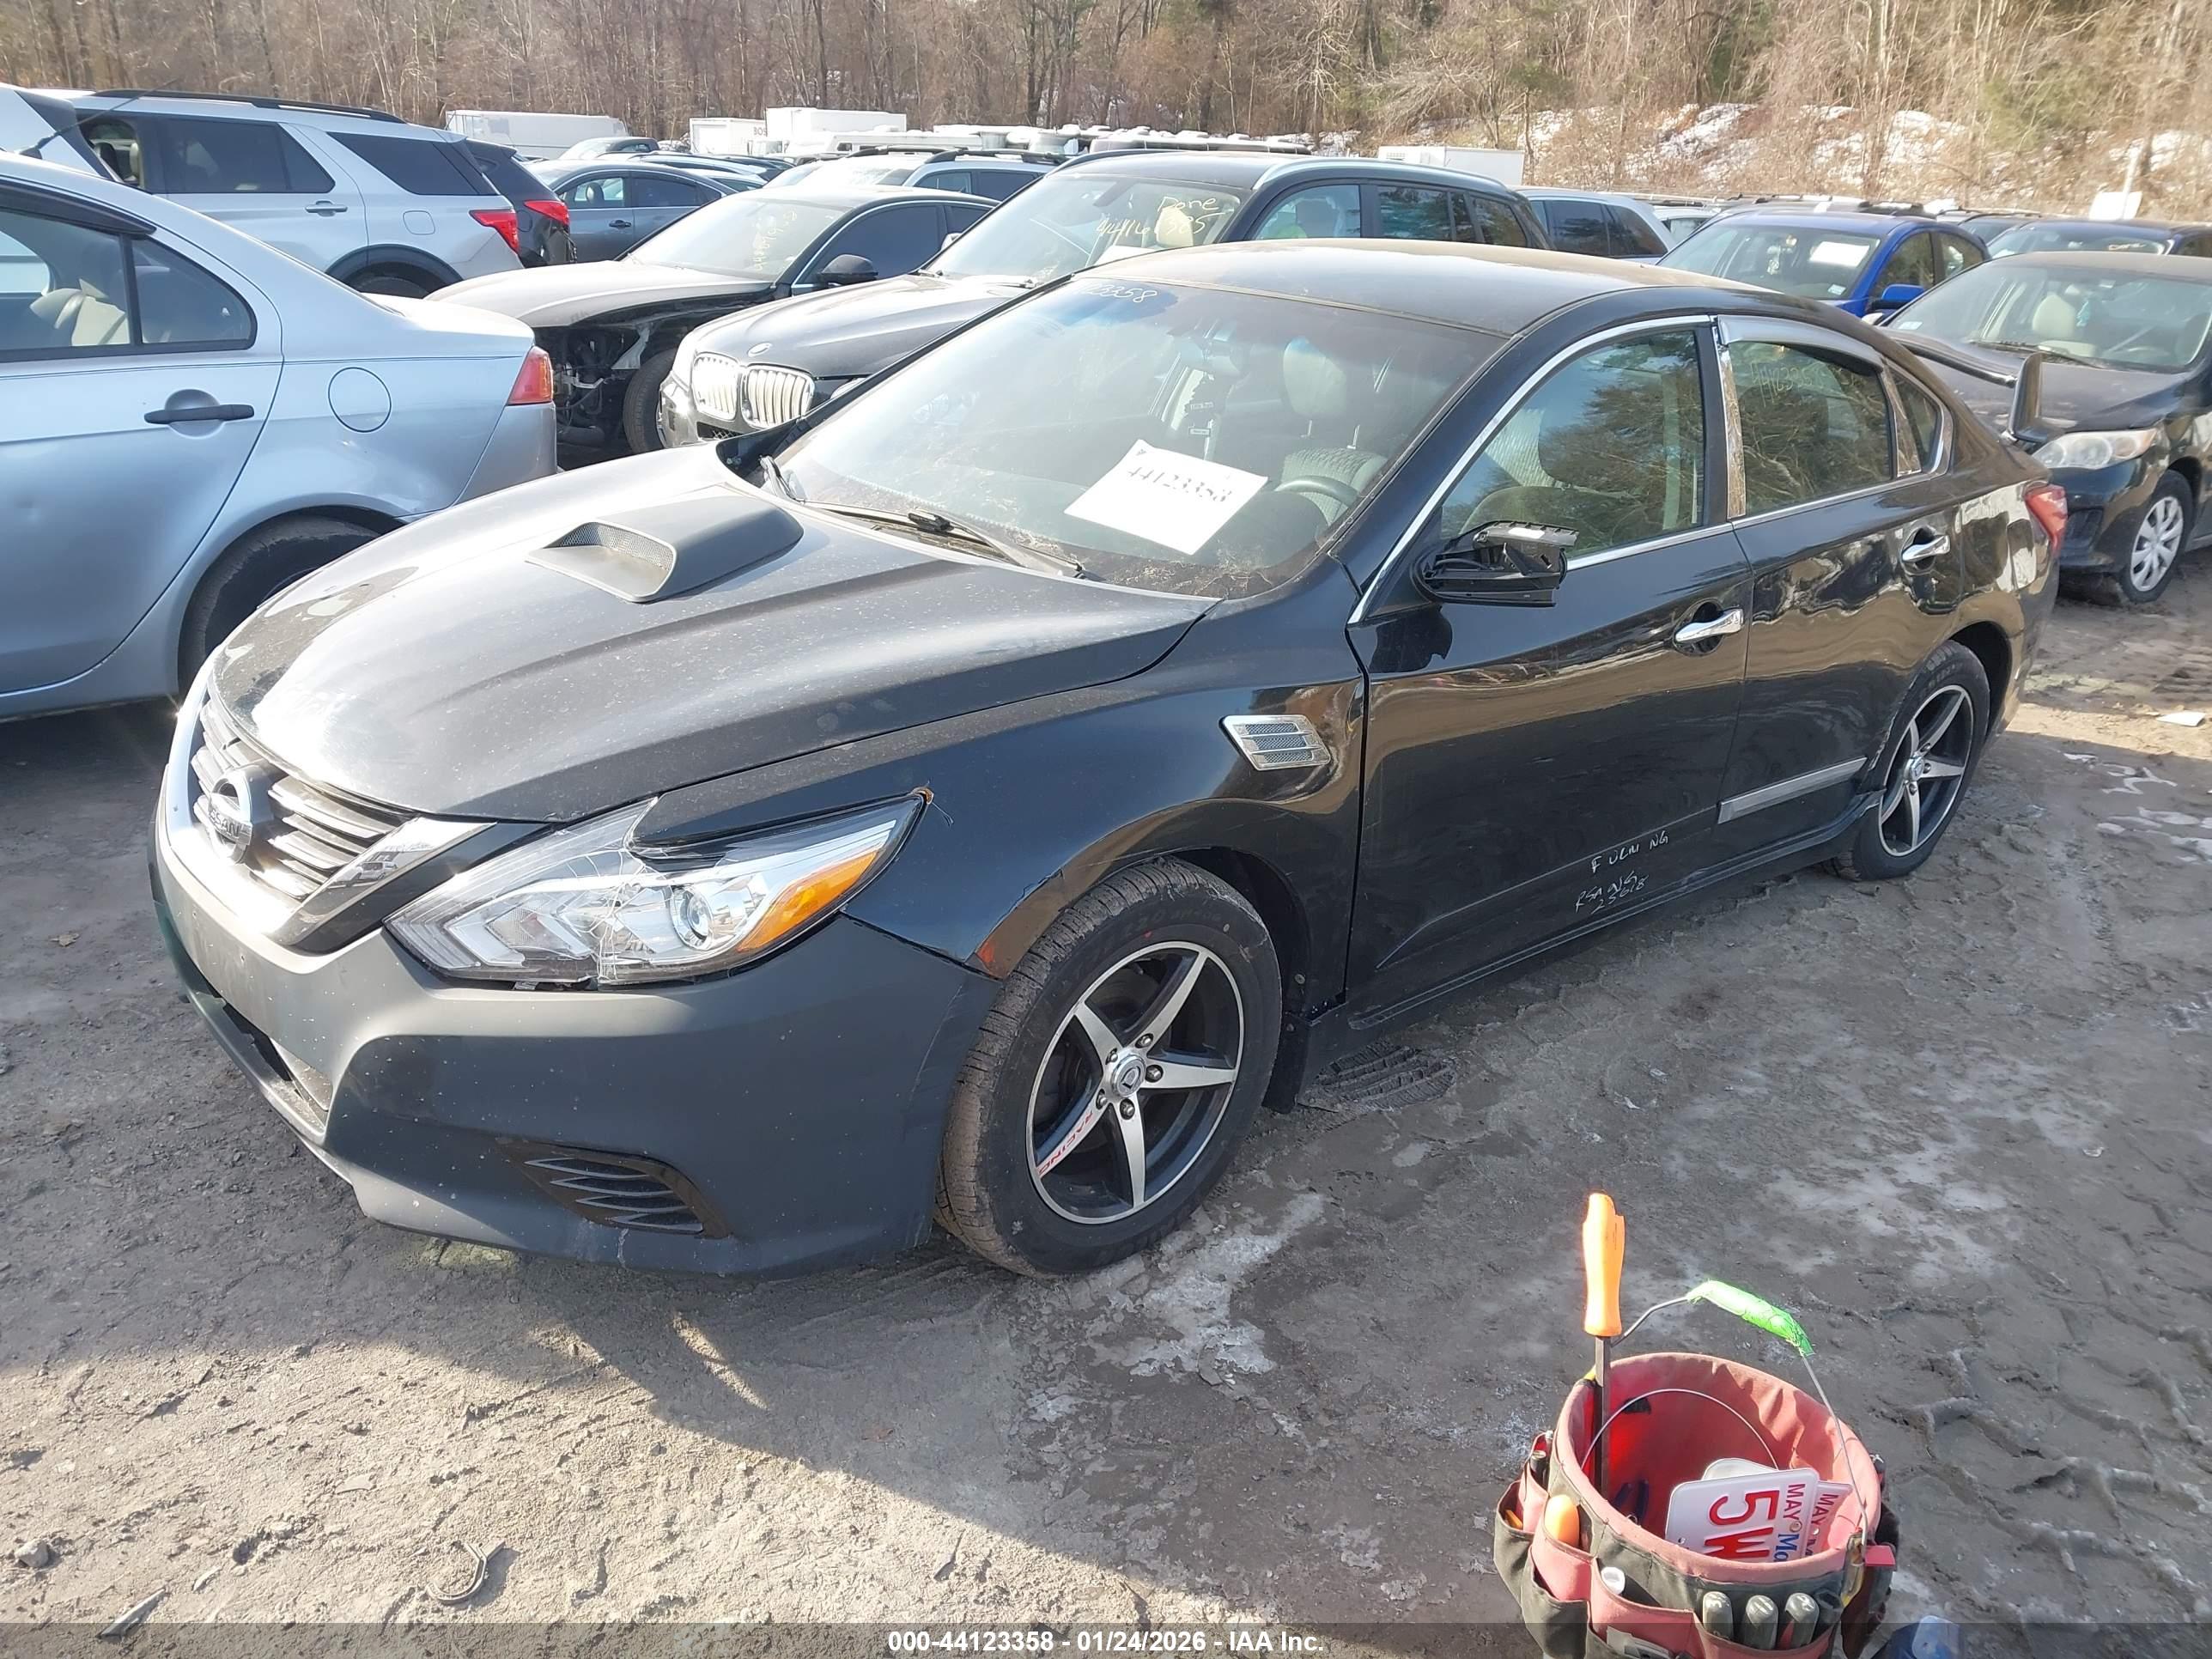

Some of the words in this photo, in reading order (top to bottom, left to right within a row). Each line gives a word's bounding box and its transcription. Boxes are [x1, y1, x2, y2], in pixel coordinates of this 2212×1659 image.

[1157, 196, 1219, 212] Done
[1127, 466, 1233, 502] 44123358
[1783, 1483, 1806, 1521] MAY
[1810, 1493, 1838, 1526] MAY
